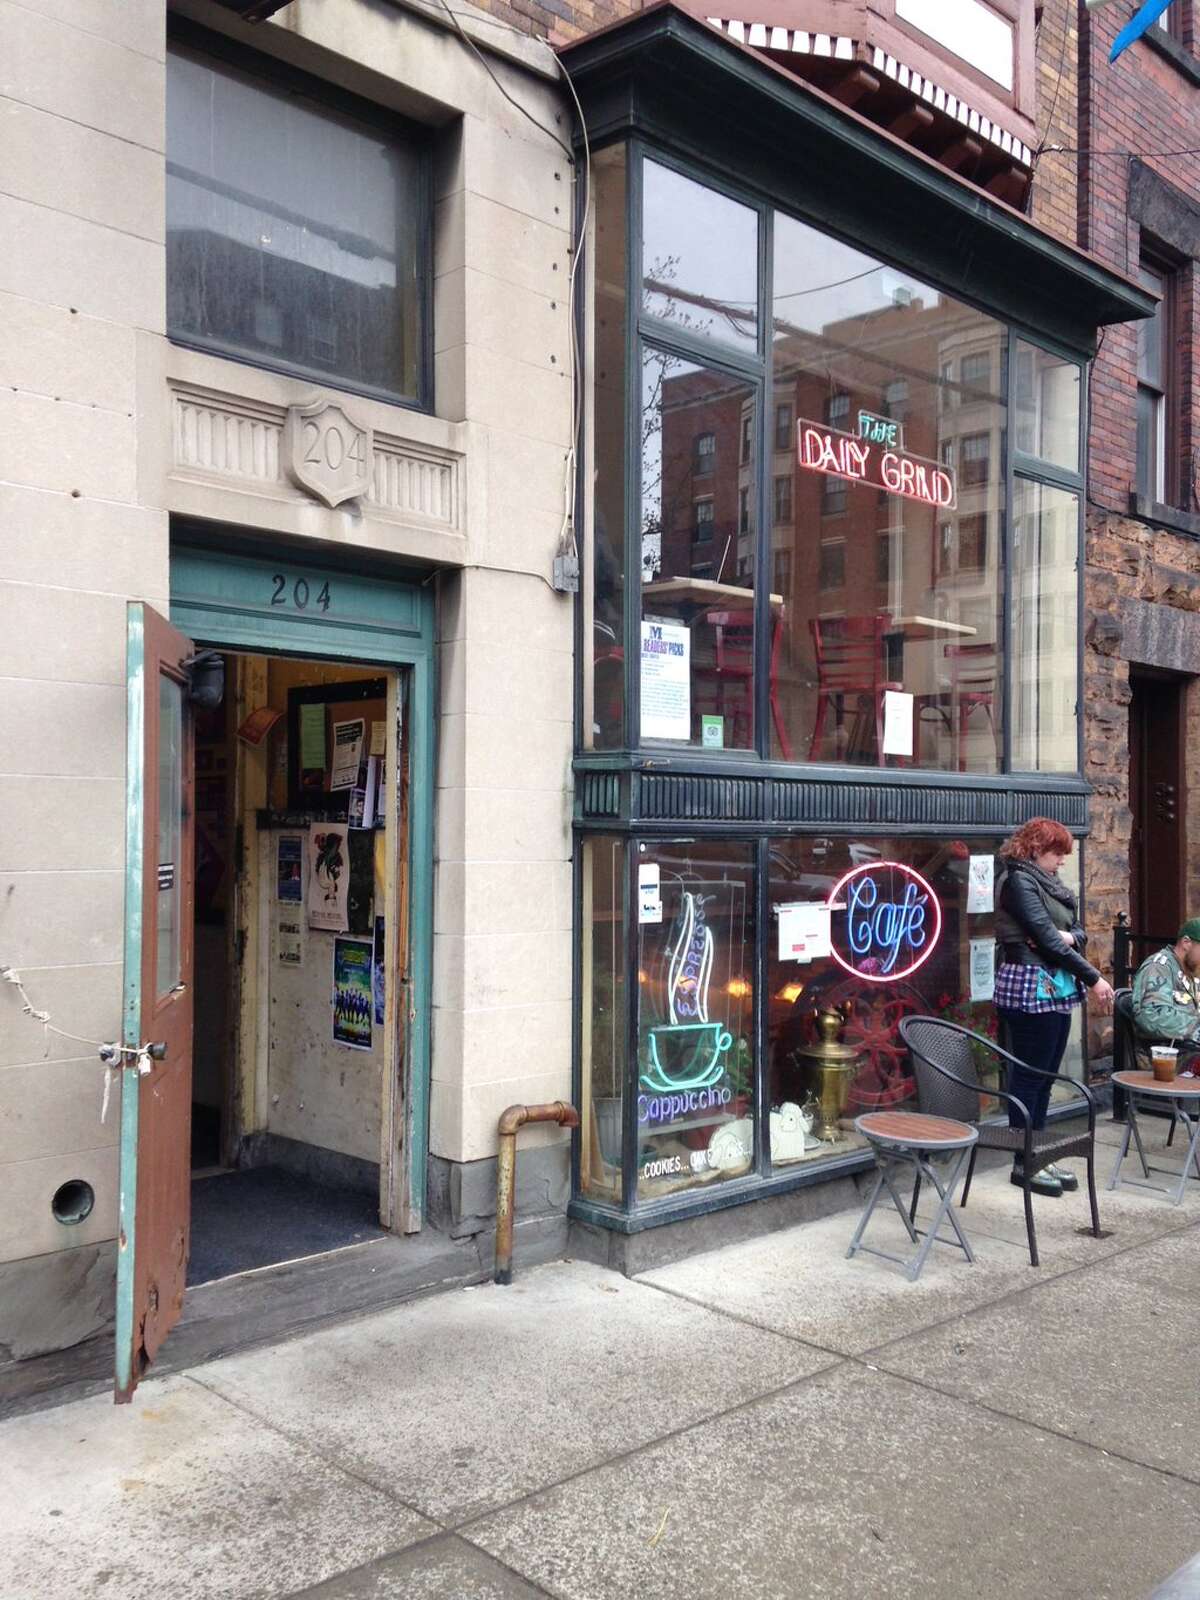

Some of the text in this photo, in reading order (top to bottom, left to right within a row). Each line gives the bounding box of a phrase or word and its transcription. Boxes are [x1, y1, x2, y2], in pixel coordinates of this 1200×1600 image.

[303, 421, 364, 479] 204
[859, 415, 898, 448] THE
[804, 428, 953, 507] DAILY GRIND
[270, 574, 330, 613] 204
[846, 876, 929, 974] Café
[638, 1085, 731, 1122] Cappuccino
